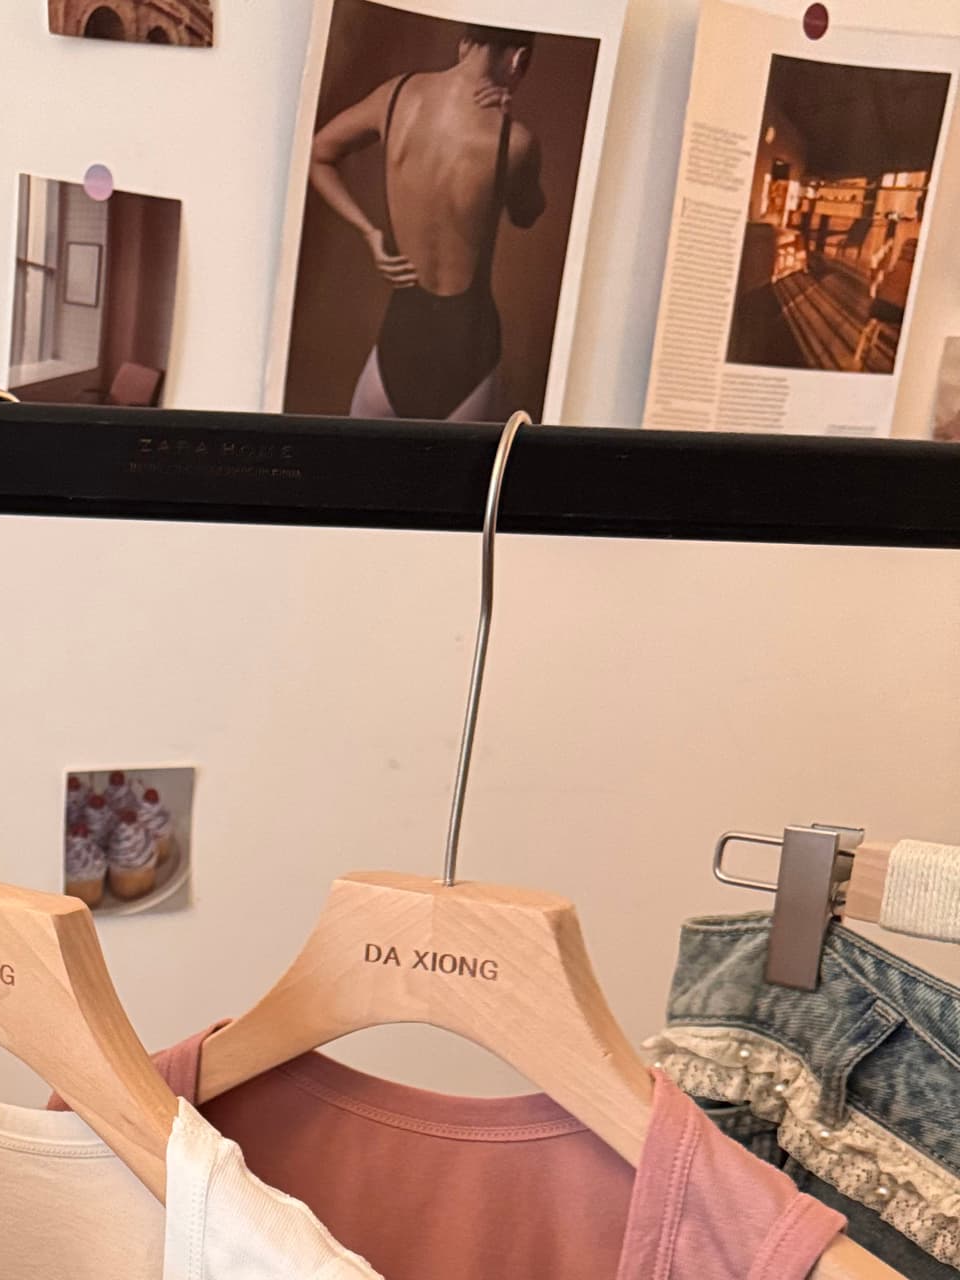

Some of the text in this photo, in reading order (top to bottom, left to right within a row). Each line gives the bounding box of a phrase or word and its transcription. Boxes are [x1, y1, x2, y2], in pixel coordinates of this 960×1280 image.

[138, 438, 208, 455] ZARA
[364, 943, 498, 981] DA XIONG
